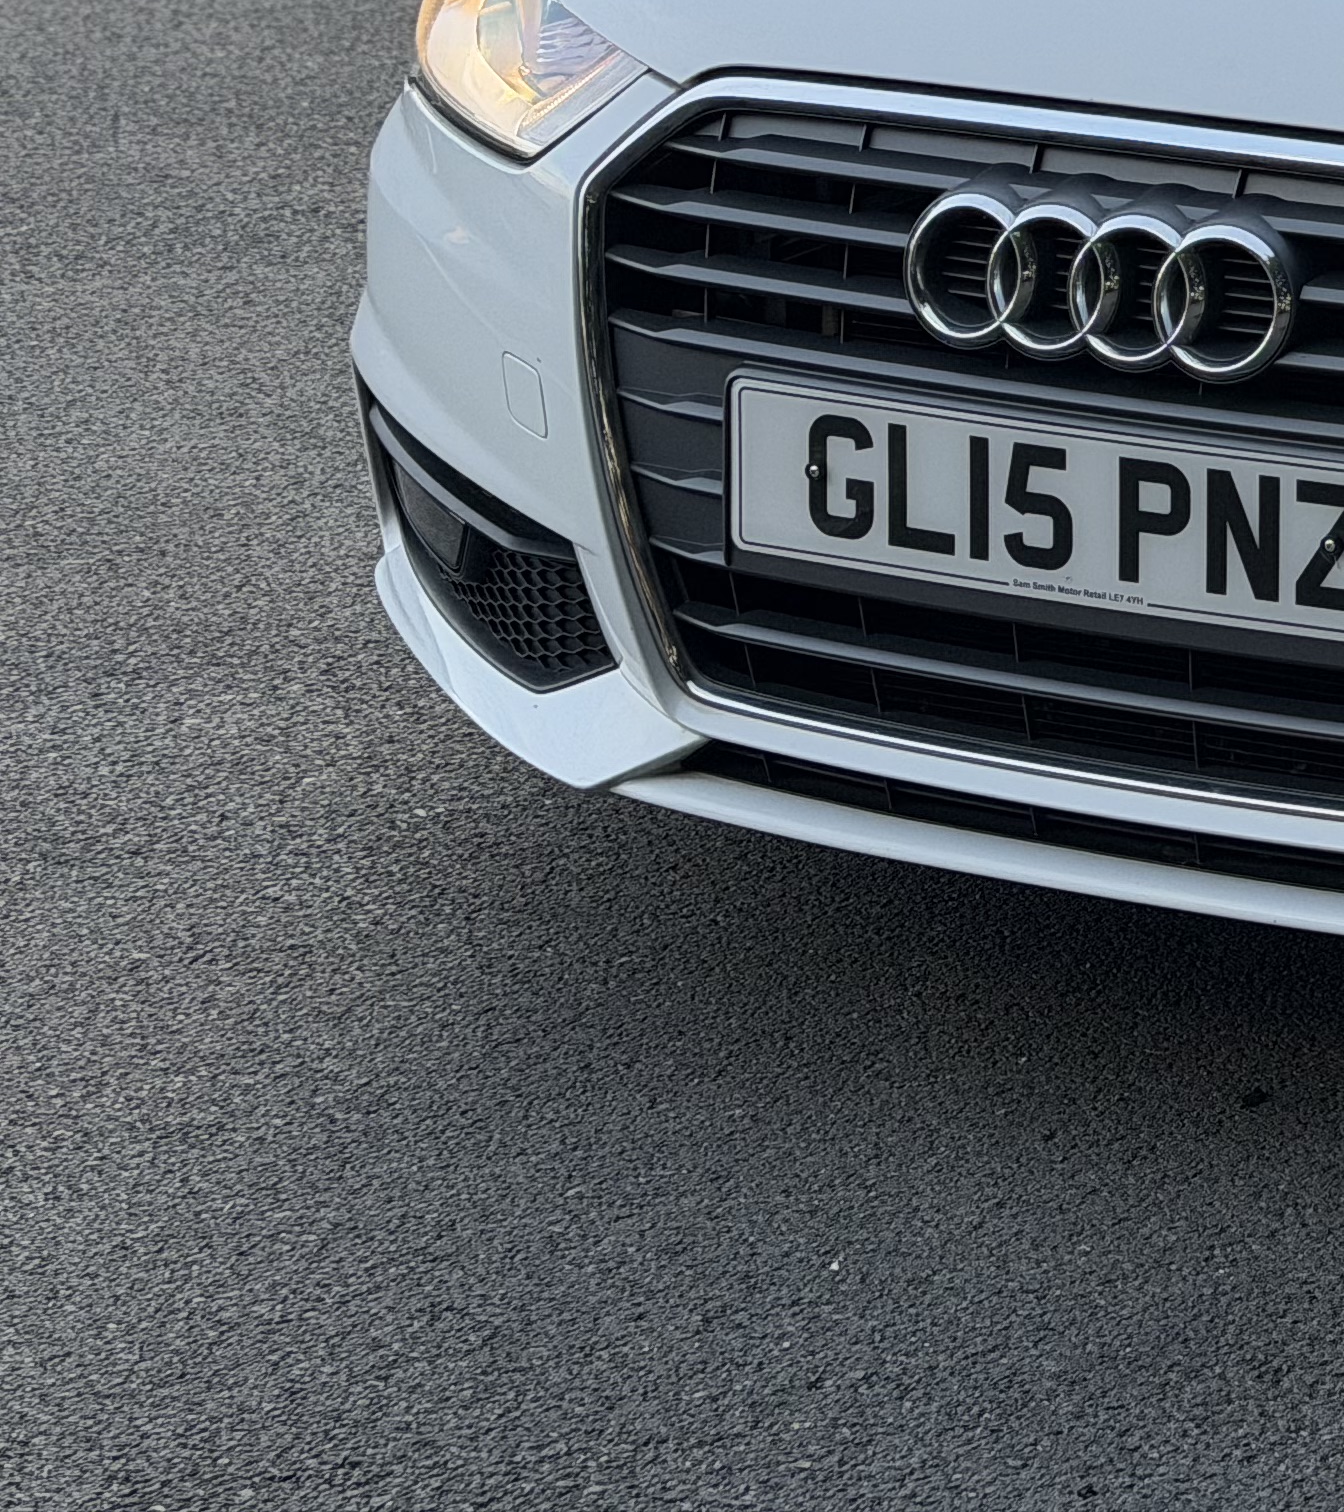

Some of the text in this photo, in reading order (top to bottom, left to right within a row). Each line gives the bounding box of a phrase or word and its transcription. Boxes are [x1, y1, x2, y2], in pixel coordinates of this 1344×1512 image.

[807, 414, 1074, 571] GL15
[1012, 578, 1031, 589] Sam
[1032, 581, 1056, 592] Smith
[1057, 585, 1082, 597] Motor
[1083, 589, 1107, 600] Retail
[1108, 592, 1124, 603] LE7
